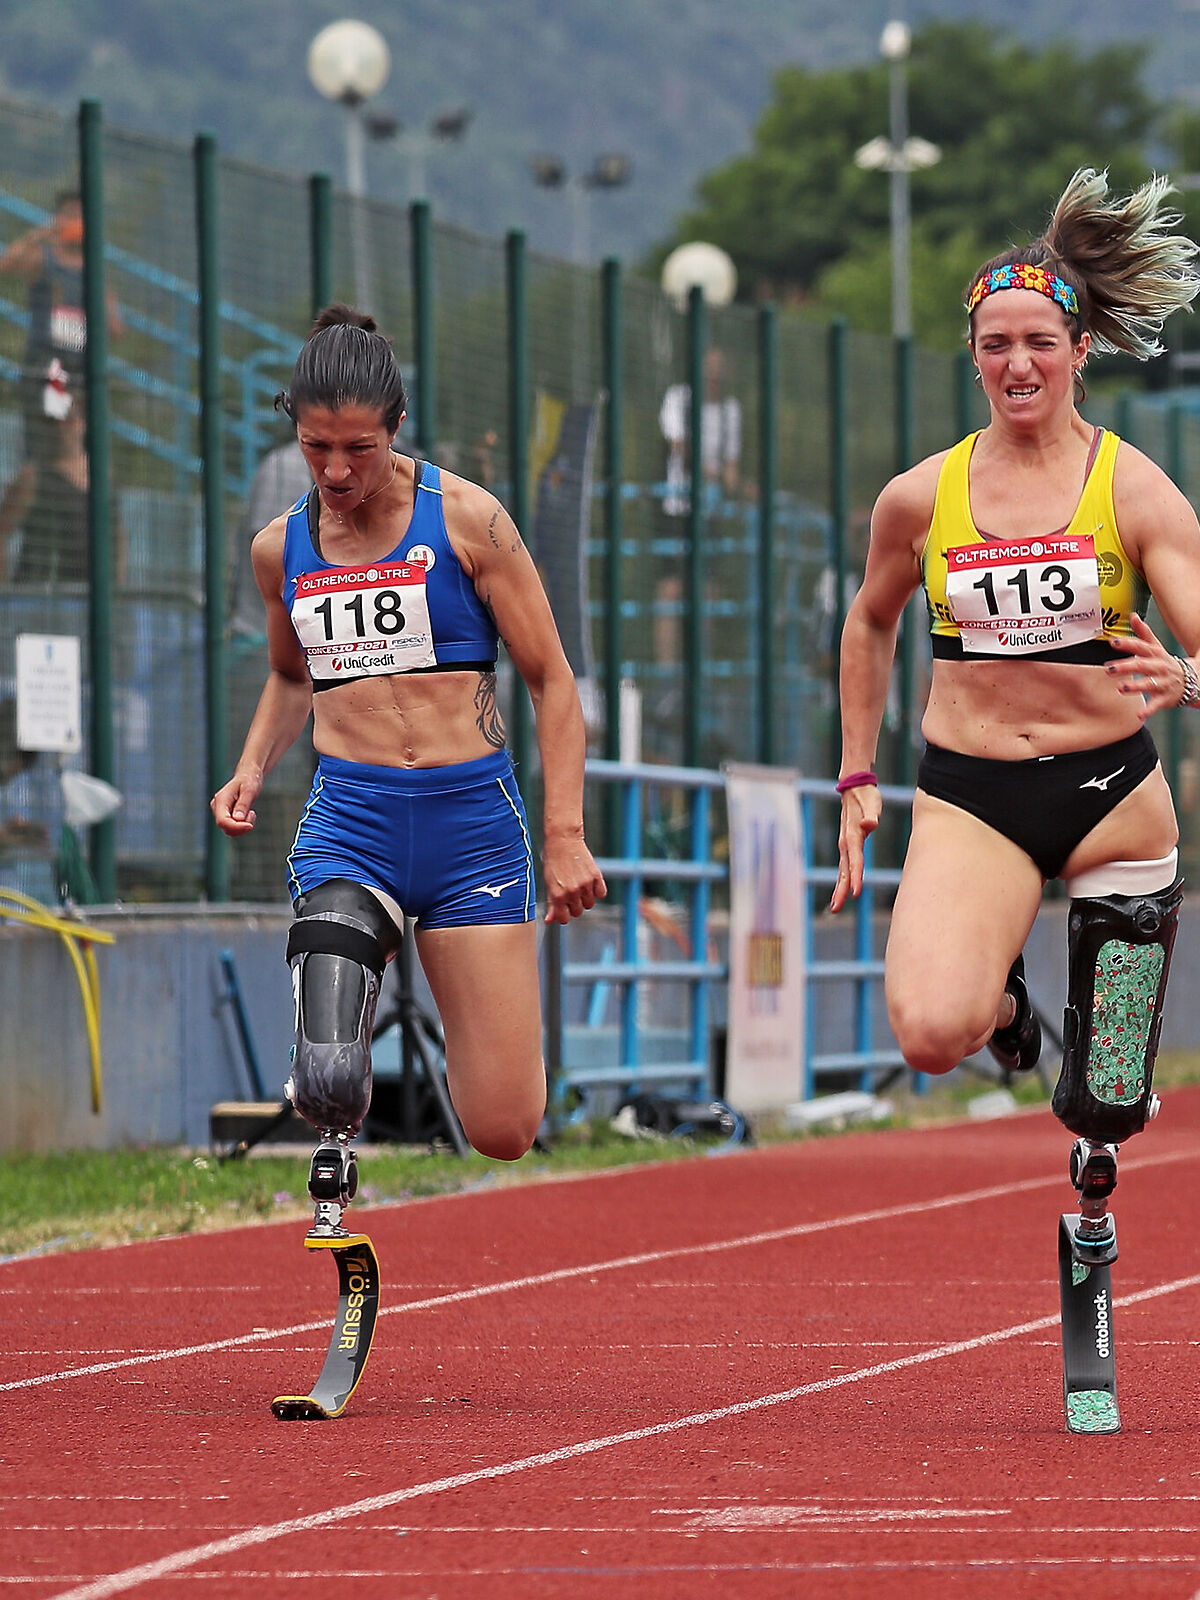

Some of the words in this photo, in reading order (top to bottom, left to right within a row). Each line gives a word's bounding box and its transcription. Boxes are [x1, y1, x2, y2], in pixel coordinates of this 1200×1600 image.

[955, 541, 1079, 564] OLTREMODOLTRE
[301, 567, 411, 590] OLTREMODOLTRE
[973, 565, 1075, 616] 113
[314, 590, 405, 641] 118
[962, 619, 1019, 629] CONCESIO
[1020, 617, 1052, 628] 2021
[307, 644, 354, 655] CONCESIO
[355, 641, 385, 651] 2021
[1009, 630, 1063, 647] UniCredit
[343, 654, 395, 669] UniCredit
[338, 1275, 370, 1350] ÖSSUR
